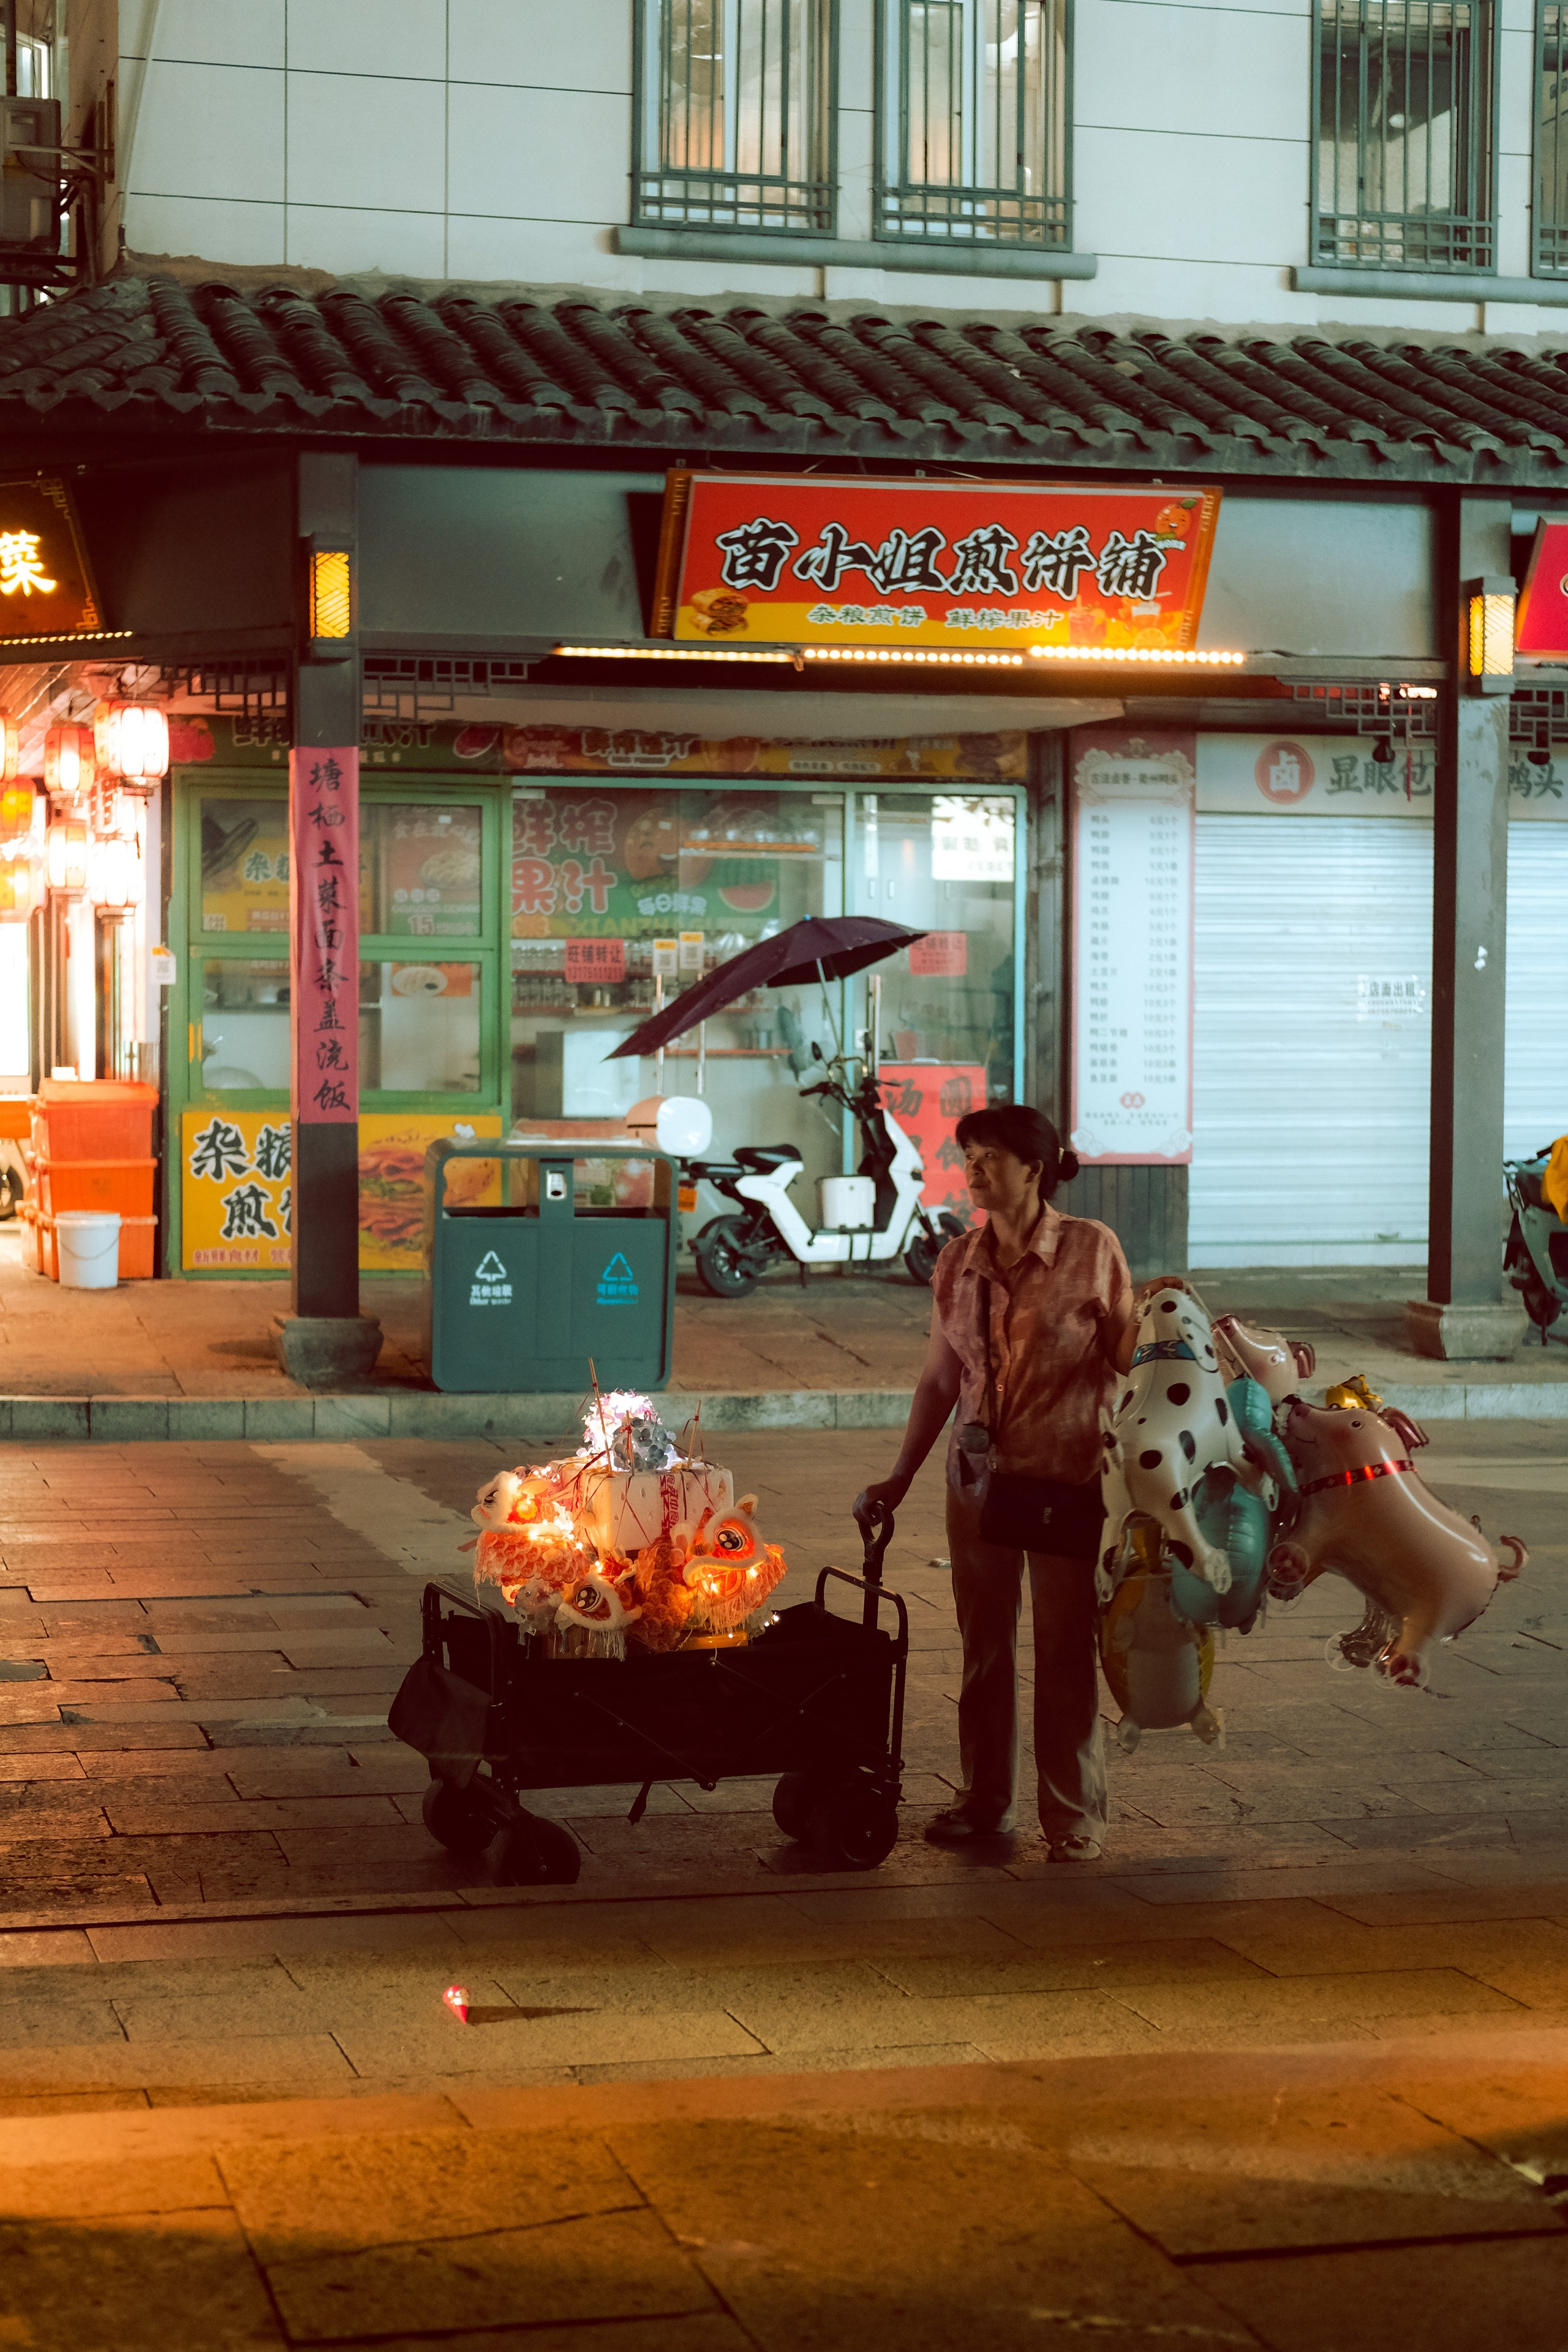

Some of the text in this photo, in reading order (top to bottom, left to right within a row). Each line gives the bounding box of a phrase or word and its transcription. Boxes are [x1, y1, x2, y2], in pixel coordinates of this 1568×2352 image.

[715, 518, 1166, 600] 苗小姐煎饼铺
[807, 603, 1064, 630] 杂粮煎饼 鲜榨果汁
[1269, 750, 1300, 794] 卤
[511, 857, 617, 915] 果汁
[568, 944, 622, 963] 旺铺转让
[219, 1180, 292, 1241] 煎
